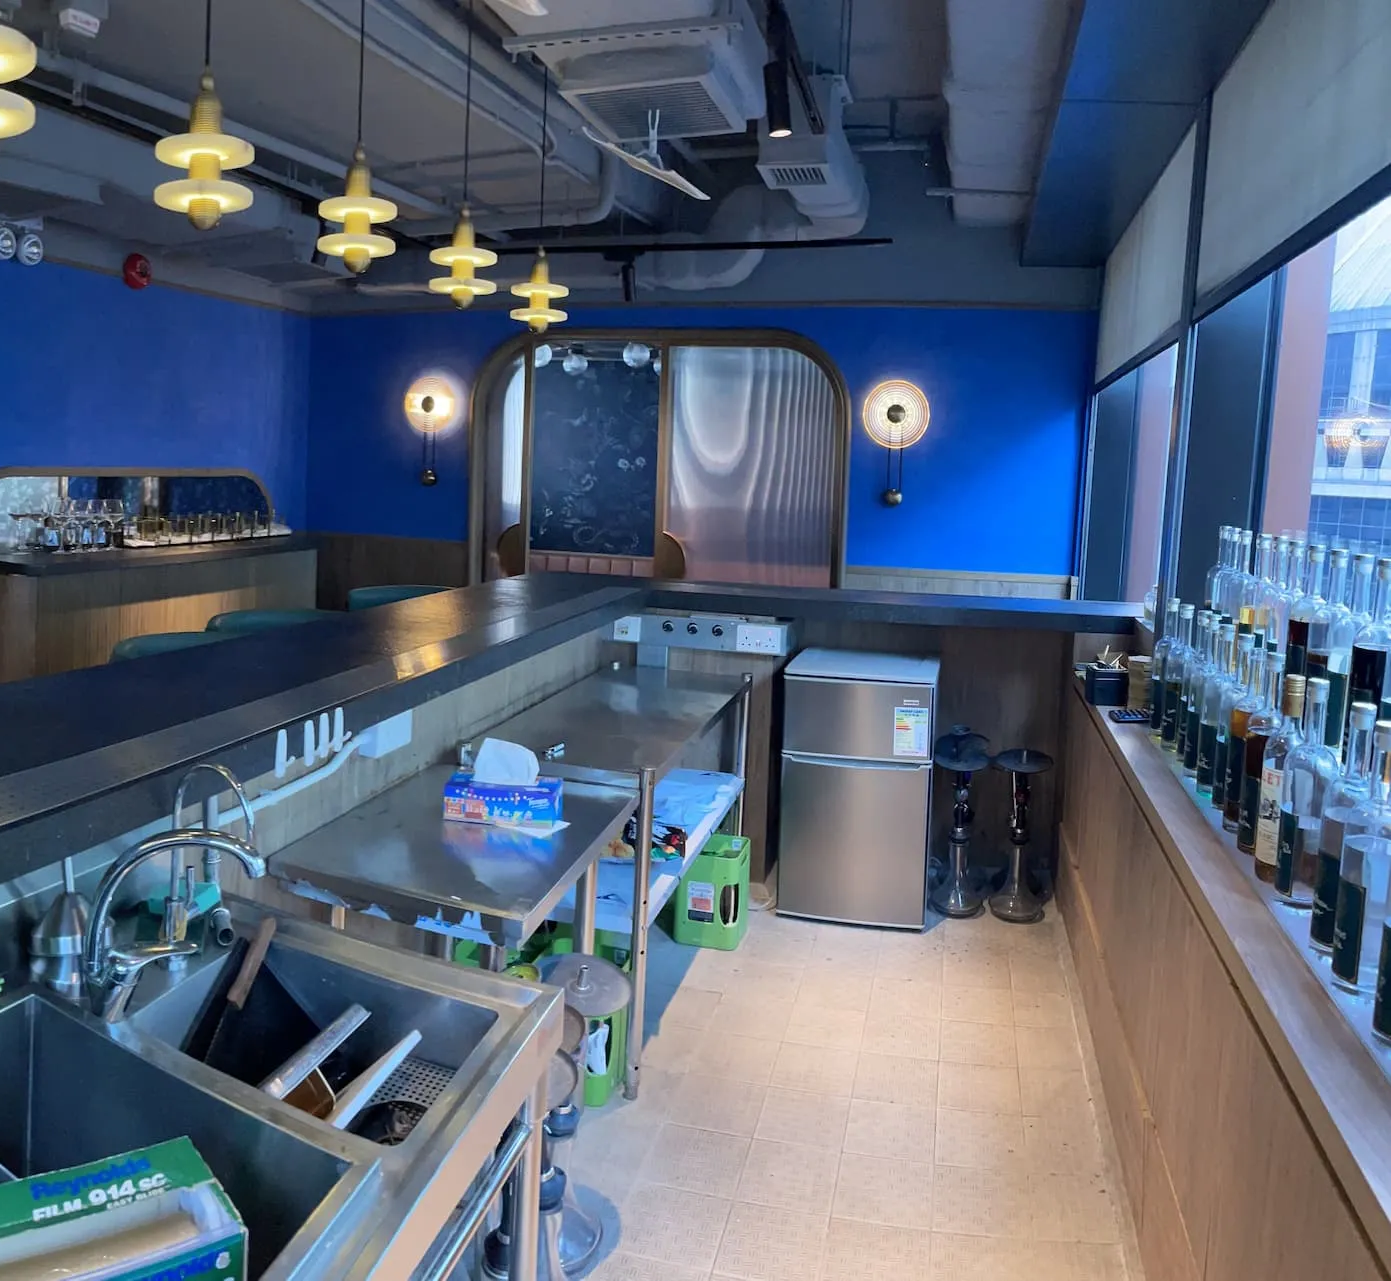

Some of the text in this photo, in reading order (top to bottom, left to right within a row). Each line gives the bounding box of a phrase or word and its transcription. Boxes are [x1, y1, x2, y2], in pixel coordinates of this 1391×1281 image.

[31, 1158, 151, 1200] Reynolds
[32, 1198, 83, 1221] FILM
[88, 1179, 136, 1206] 914
